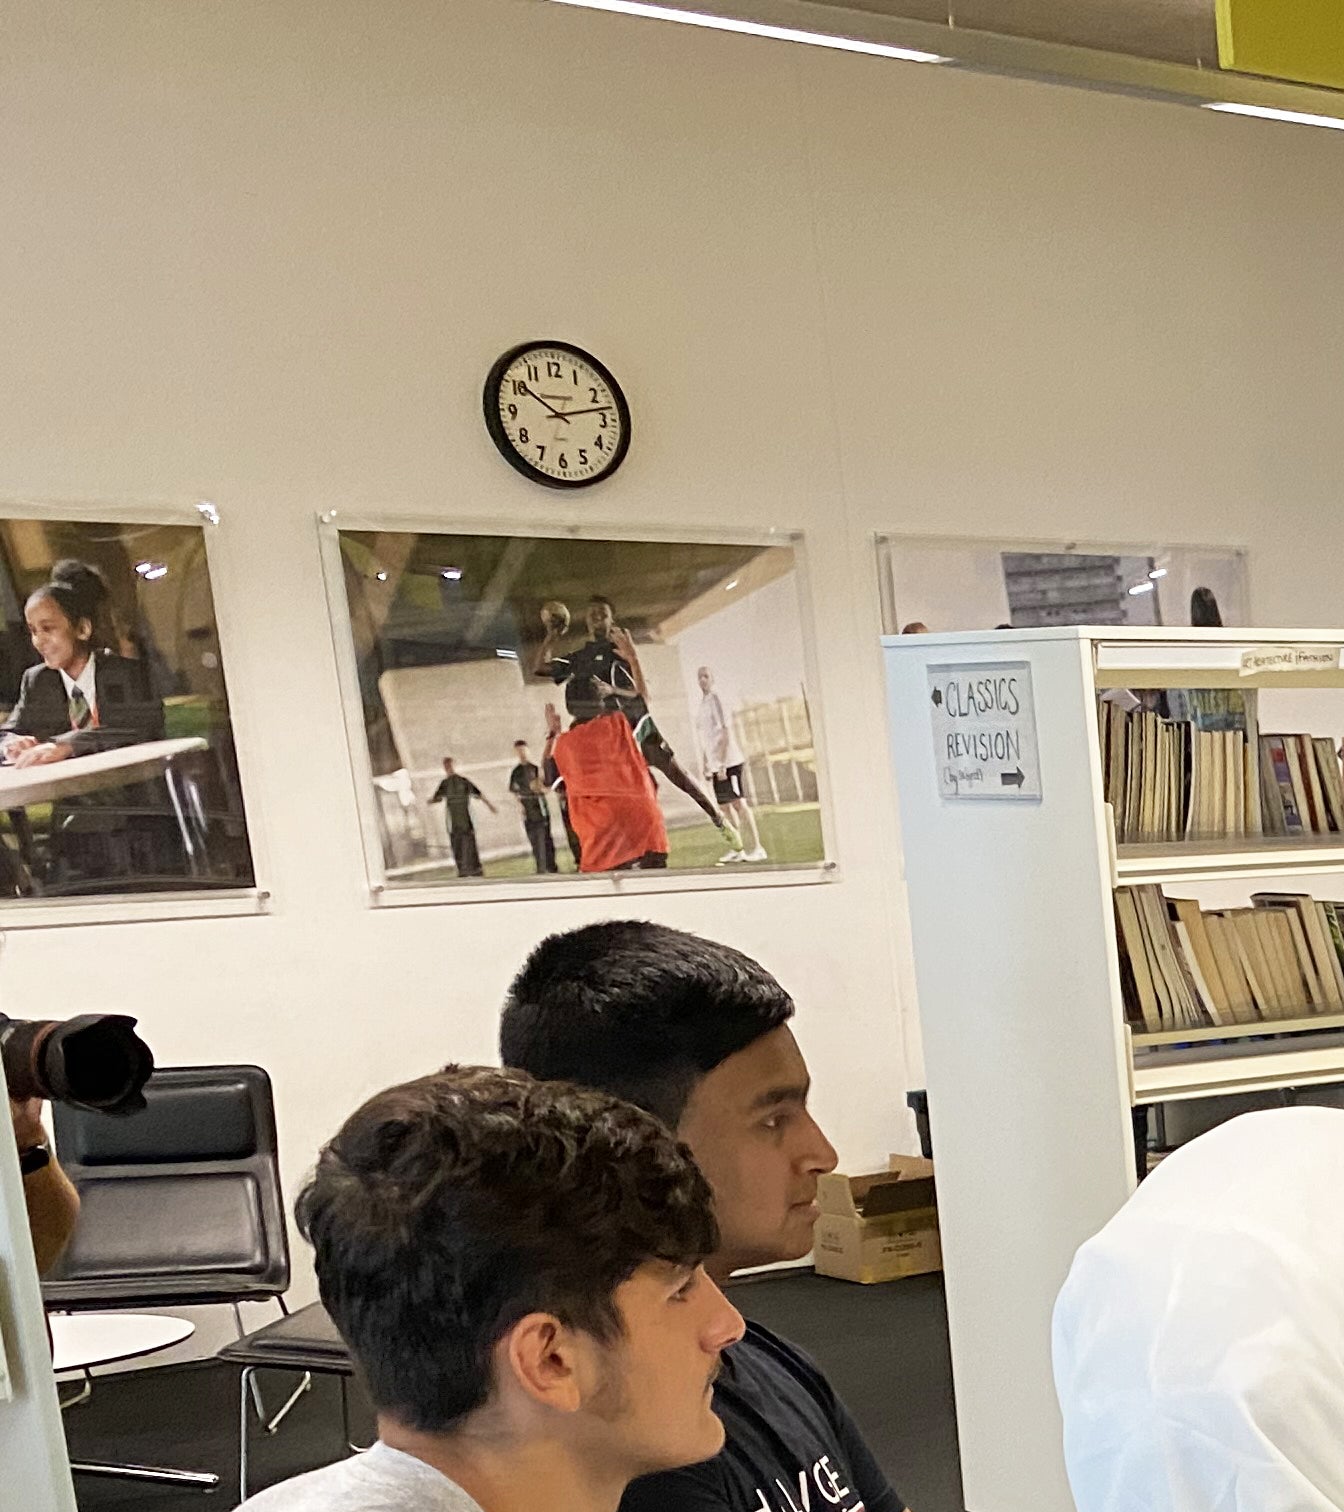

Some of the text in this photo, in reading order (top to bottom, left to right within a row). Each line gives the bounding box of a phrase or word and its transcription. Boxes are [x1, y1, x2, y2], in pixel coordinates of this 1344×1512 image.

[527, 364, 538, 382] 11
[546, 361, 562, 379] 12
[572, 369, 578, 386] 1
[588, 387, 599, 403] 2
[508, 404, 518, 420] 9
[599, 412, 607, 428] 3
[519, 427, 529, 443] 8
[594, 434, 603, 450] 4
[536, 445, 545, 461] 7
[558, 453, 568, 468] 6
[578, 449, 588, 465] 5
[945, 678, 1019, 717] CLASSICS
[946, 730, 1020, 762] REVISION
